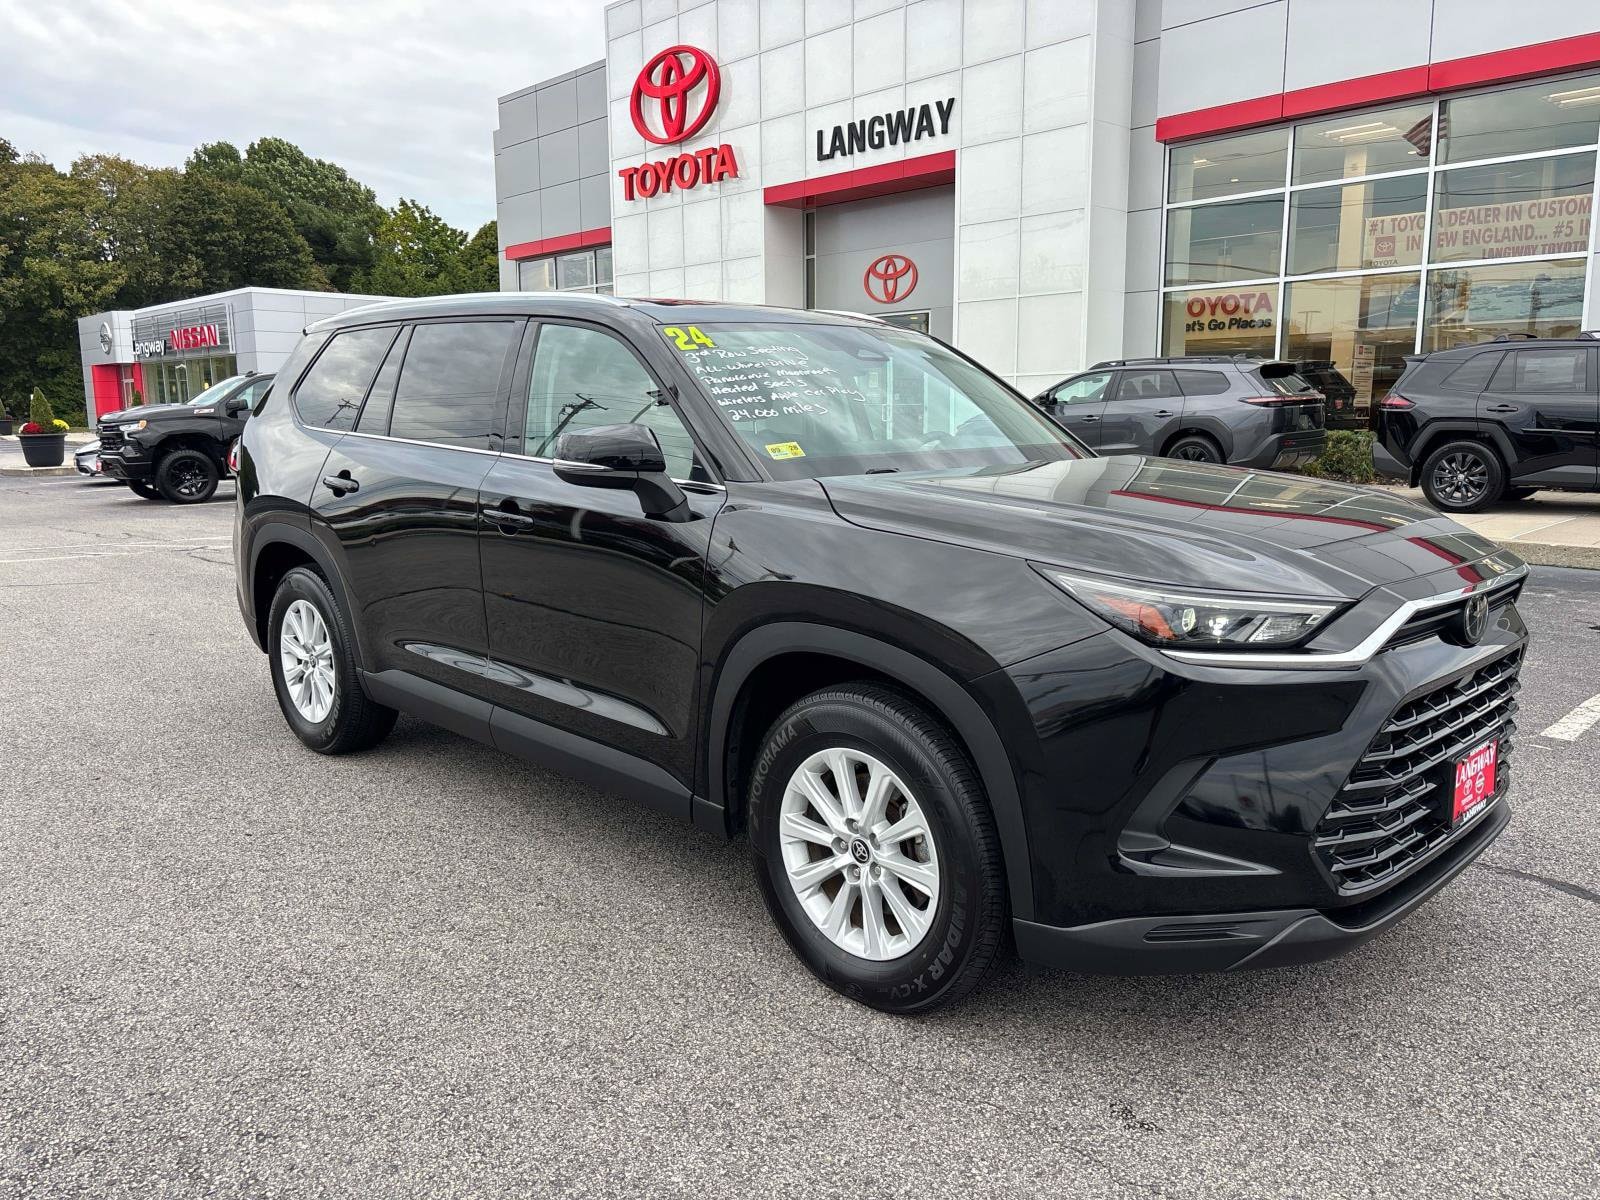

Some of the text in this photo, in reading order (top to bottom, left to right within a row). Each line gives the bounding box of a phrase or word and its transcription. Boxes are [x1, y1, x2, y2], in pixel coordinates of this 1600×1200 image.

[816, 97, 955, 161] LANGWAY
[618, 144, 739, 201] TOYOTA
[1369, 219, 1385, 236] #1
[1391, 213, 1443, 233] TOYOA
[1448, 207, 1500, 227] DEALER
[1506, 205, 1522, 222] IN
[1406, 234, 1421, 251] IN
[1437, 231, 1458, 249] EW
[1463, 223, 1548, 246] ENGLAND...
[1553, 220, 1574, 239] #5
[1482, 240, 1587, 259] LANGWAY TOYOTA
[1187, 293, 1272, 317] OYOTA
[664, 326, 717, 351] 24
[1208, 318, 1225, 331] Go
[1228, 317, 1272, 330] Places
[132, 324, 219, 357] Langway NISSAN
[751, 724, 798, 804] YOKOHAMA
[1456, 743, 1496, 788] LANGWAY
